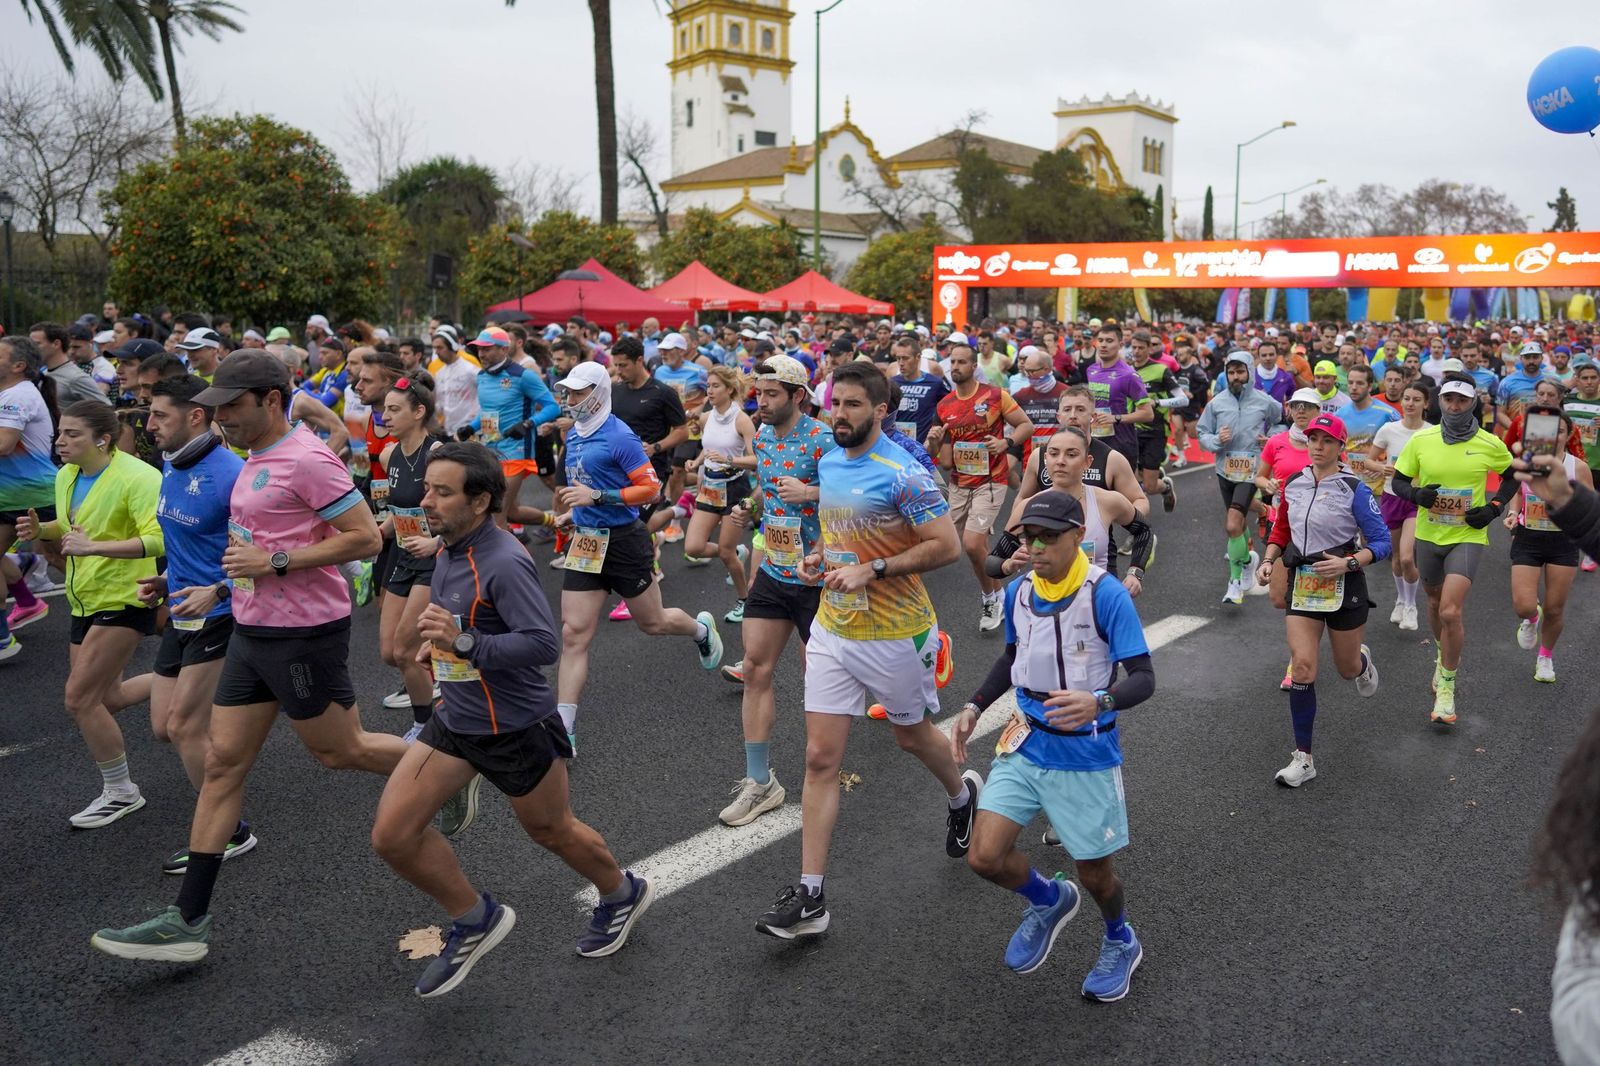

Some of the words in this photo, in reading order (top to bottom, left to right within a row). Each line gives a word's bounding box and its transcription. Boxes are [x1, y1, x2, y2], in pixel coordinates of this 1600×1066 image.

[959, 449, 981, 461] 7524
[1229, 458, 1250, 469] 8070
[766, 526, 790, 545] 7805
[576, 536, 598, 553] 4529
